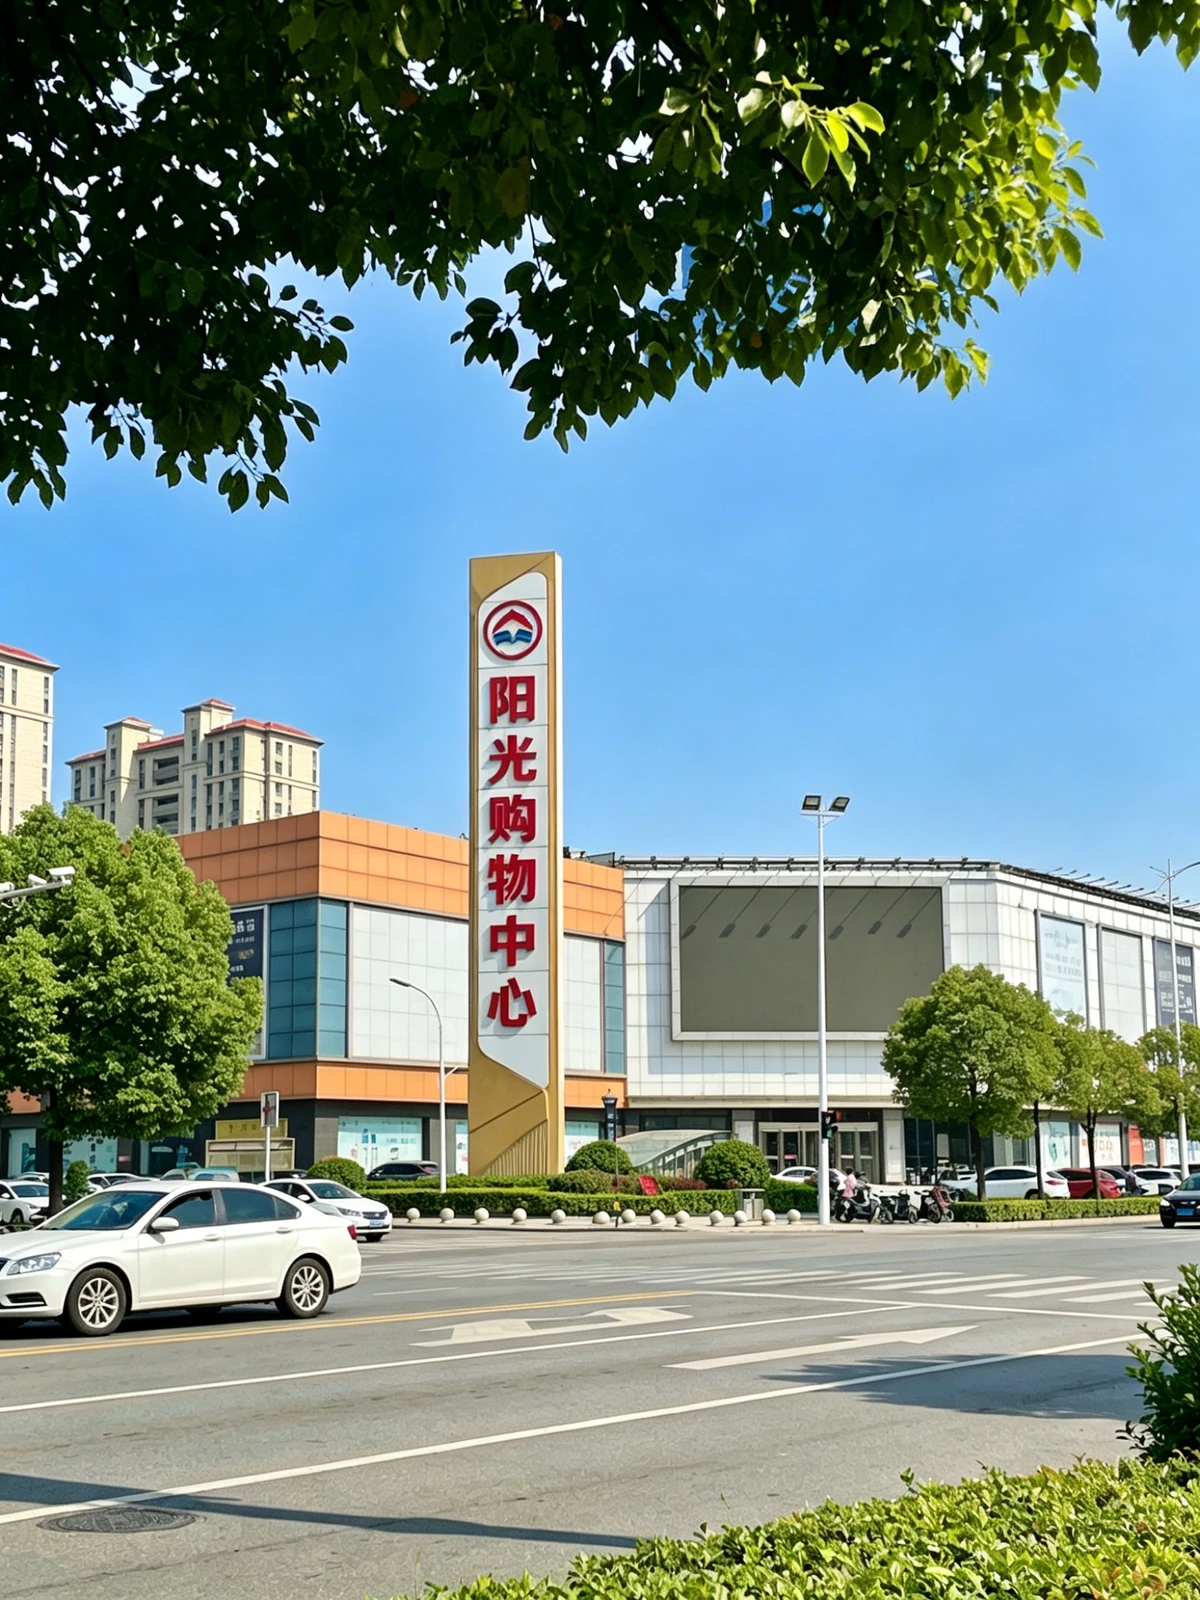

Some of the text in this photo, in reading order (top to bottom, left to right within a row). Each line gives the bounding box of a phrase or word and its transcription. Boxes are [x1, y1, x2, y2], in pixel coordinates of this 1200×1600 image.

[488, 675, 537, 1027] 阳光购物中心
